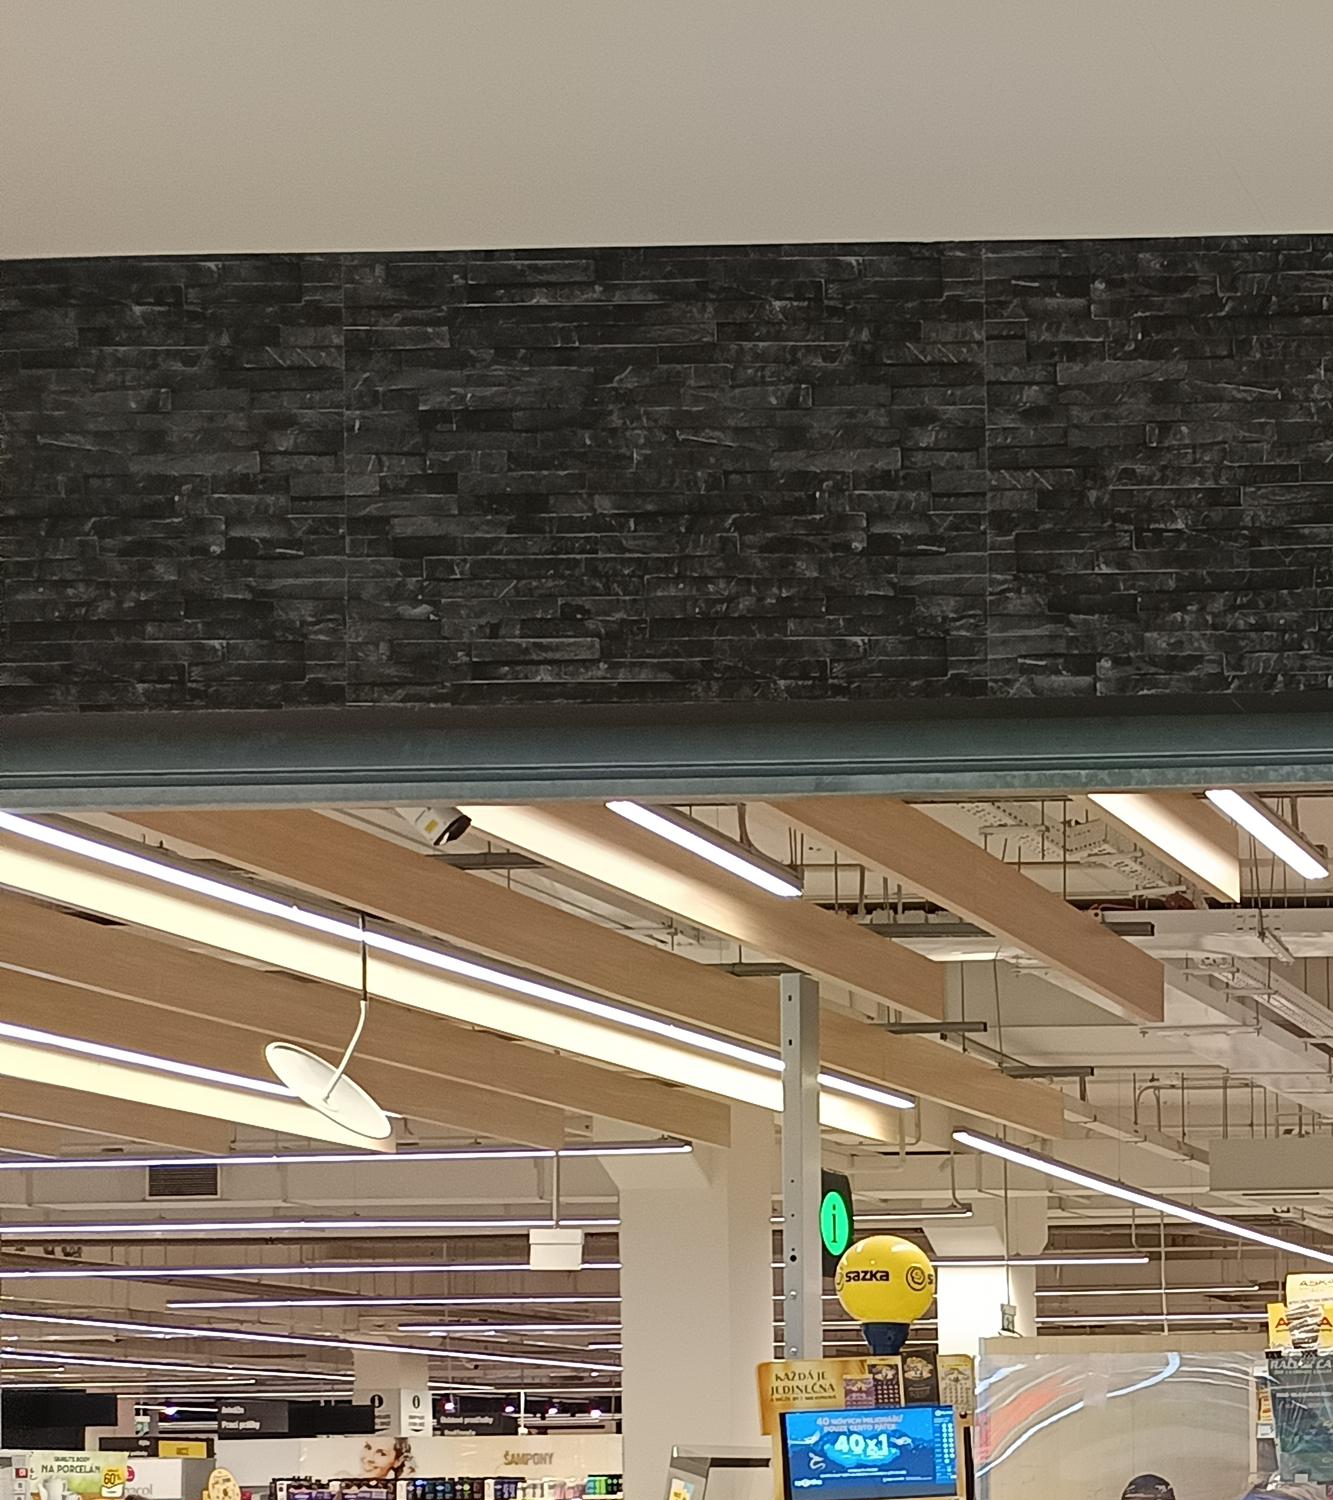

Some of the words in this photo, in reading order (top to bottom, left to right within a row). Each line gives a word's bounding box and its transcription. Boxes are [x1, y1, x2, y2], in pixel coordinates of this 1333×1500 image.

[845, 1269, 890, 1283] sazka
[775, 1369, 814, 1382] KAŽDÁ
[817, 1371, 827, 1382] JE
[504, 1451, 554, 1466] ŠAMPONY
[41, 1464, 55, 1475] NA
[57, 1461, 101, 1476] PORCELÁN
